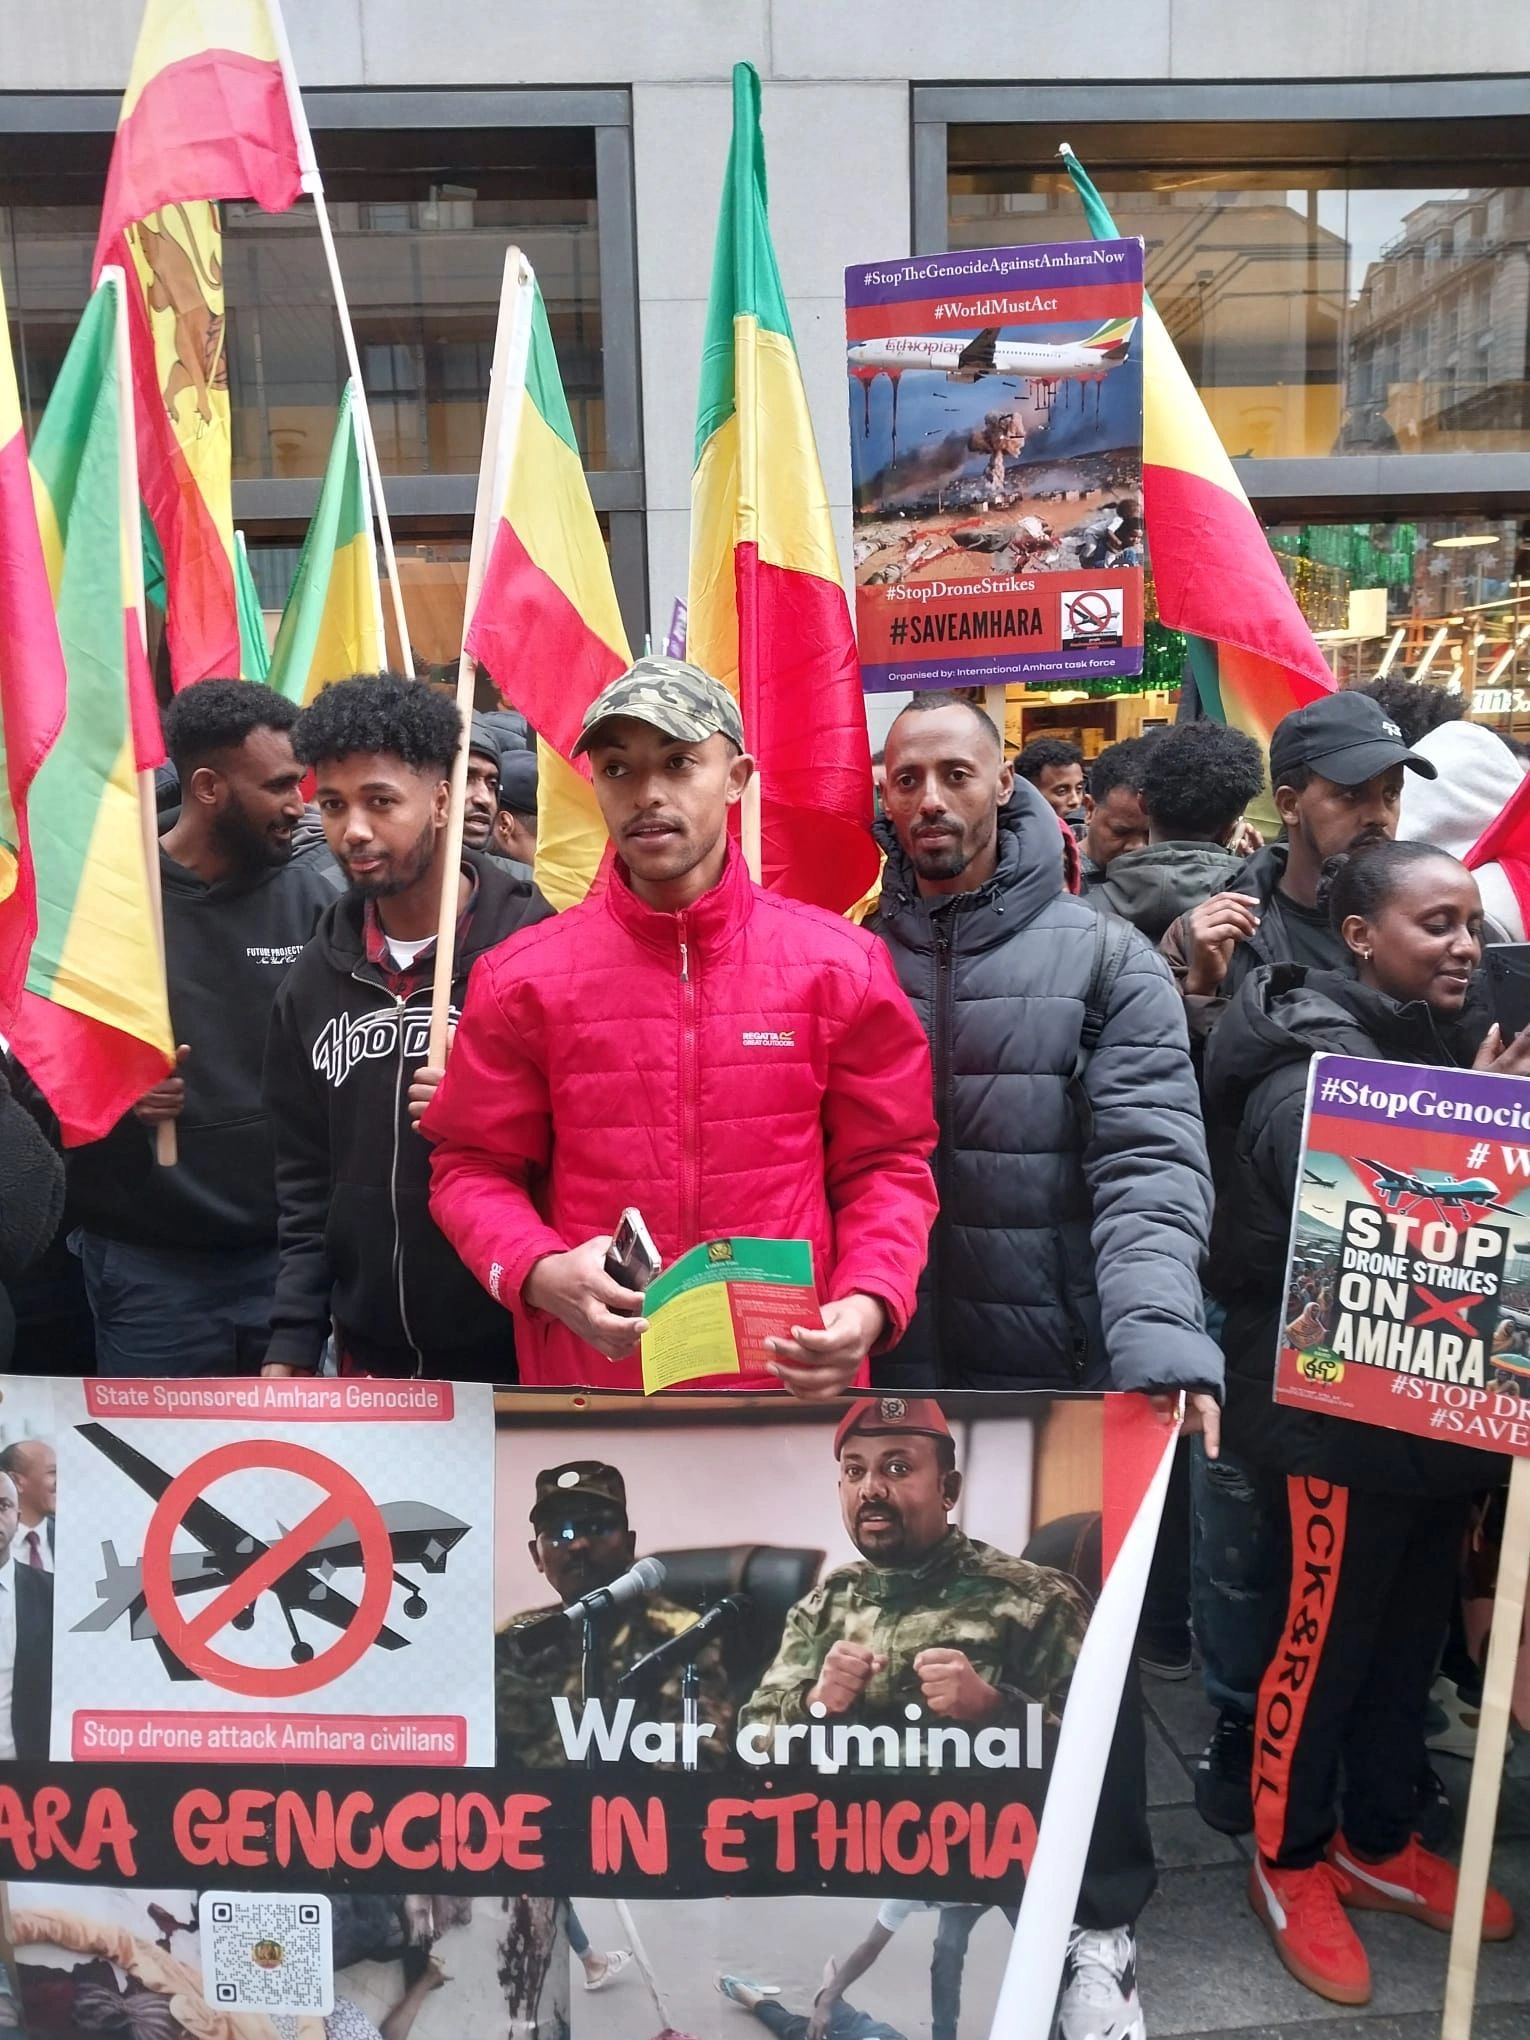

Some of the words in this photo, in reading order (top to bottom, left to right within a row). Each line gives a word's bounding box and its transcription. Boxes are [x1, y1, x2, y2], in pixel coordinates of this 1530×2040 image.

[864, 250, 1125, 286] #StopTheGenocideAgainstAmharaNow
[934, 296, 1057, 320] #WorldMustAct
[886, 339, 964, 355] Ethiopian
[886, 577, 1035, 603] #StopDroneStrikes
[890, 607, 1043, 645] #SAVEAMHARA
[888, 668, 939, 681] Organised
[940, 668, 956, 678] by:
[957, 664, 1021, 677] International
[1022, 662, 1063, 673] Amhara
[1064, 660, 1087, 670] task
[1088, 658, 1116, 668] force
[742, 1032, 779, 1040] REGATTA
[1346, 1207, 1502, 1268] STOP
[1342, 1246, 1411, 1281] DRONE
[1412, 1260, 1499, 1296] STRIKES
[1338, 1272, 1409, 1321] ON
[1331, 1312, 1485, 1388] AMHARA
[95, 1385, 149, 1406] State
[153, 1386, 260, 1412] Sponsored
[263, 1387, 342, 1408] Amhara
[346, 1386, 439, 1409] Genocide
[1391, 1375, 1488, 1411] #STOP
[1429, 1407, 1529, 1447] #SAVE
[83, 1721, 134, 1755] Stop
[139, 1723, 202, 1748] drone
[207, 1724, 277, 1750] attack
[281, 1725, 365, 1751] Amhara
[371, 1726, 455, 1753] civilians
[551, 1696, 716, 1763] War
[736, 1701, 1044, 1769] criminal
[0, 1784, 138, 1876] ARA
[172, 1788, 553, 1873] GENOCIDE
[591, 1795, 669, 1875] IN
[703, 1793, 1039, 1880] ETHIOPIA
